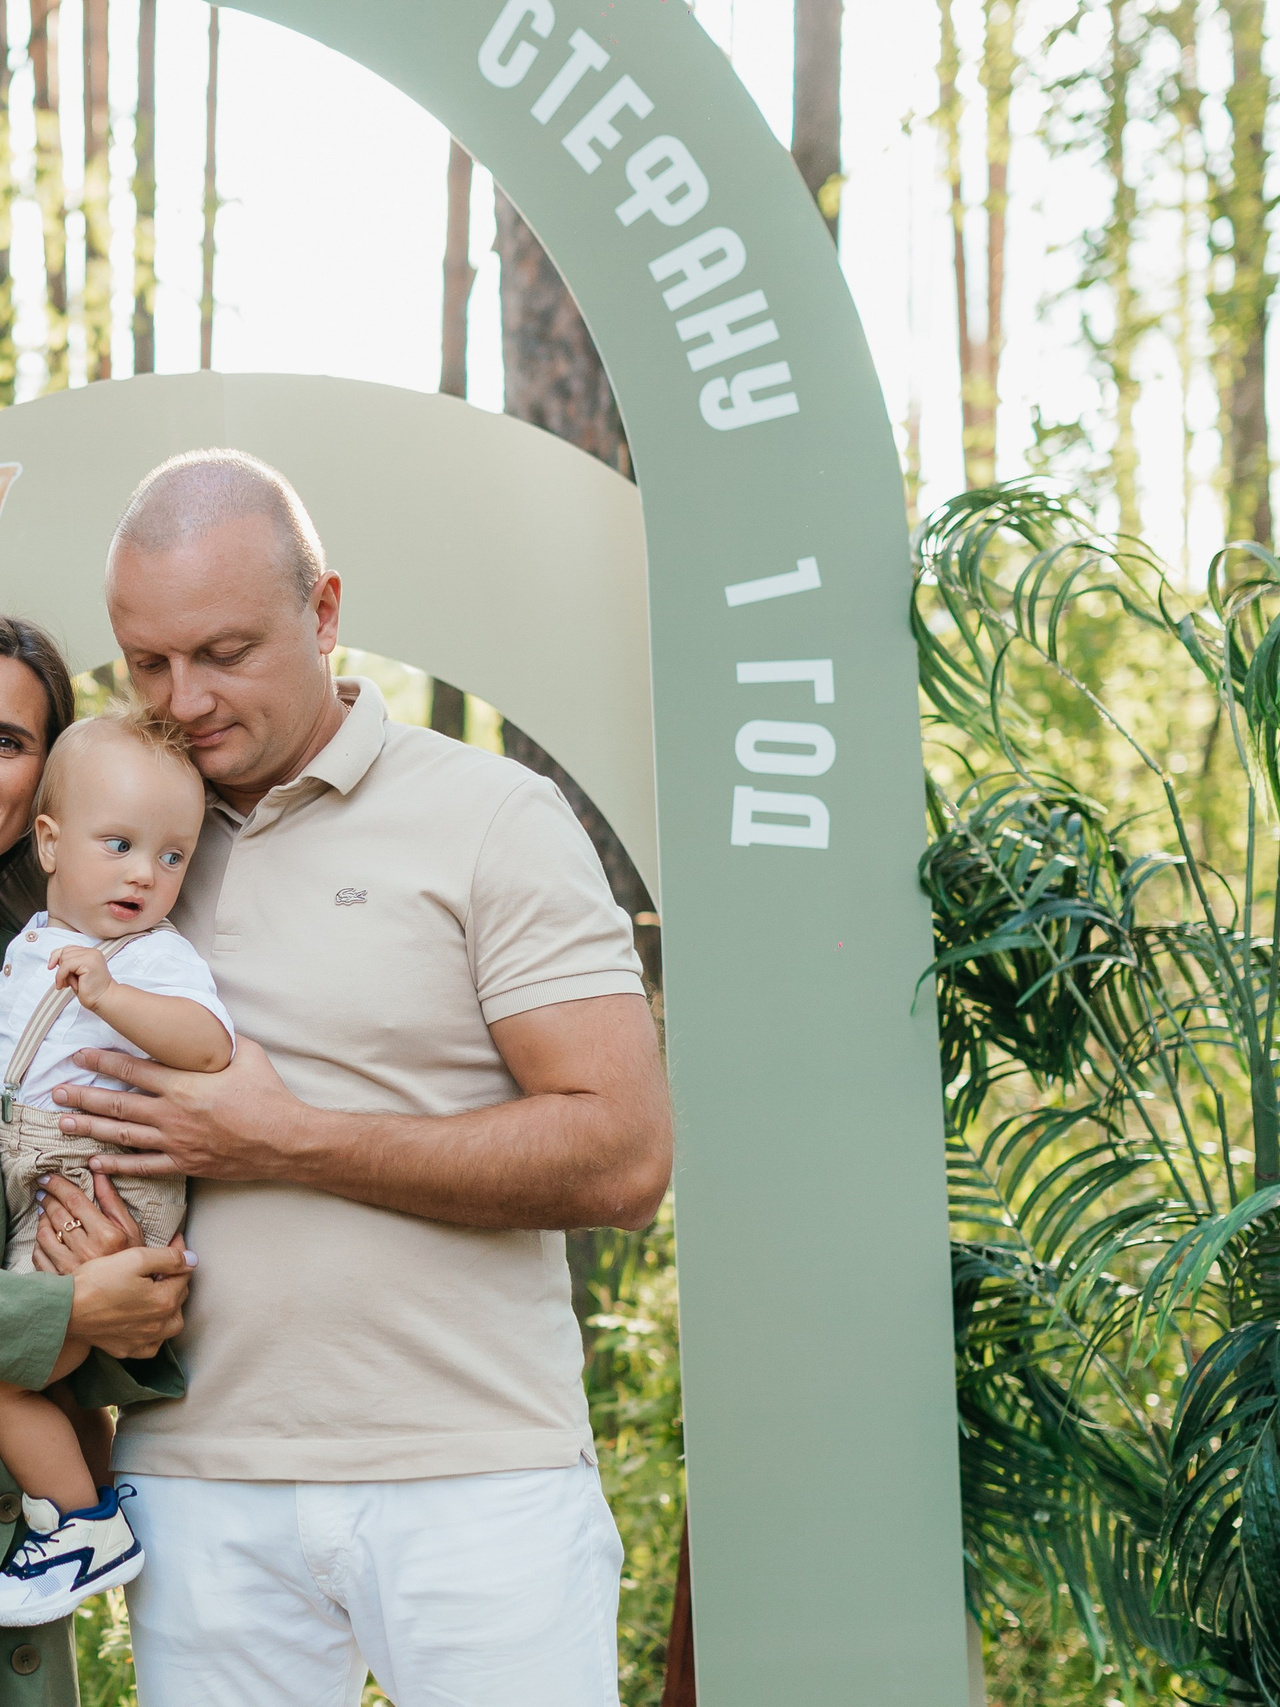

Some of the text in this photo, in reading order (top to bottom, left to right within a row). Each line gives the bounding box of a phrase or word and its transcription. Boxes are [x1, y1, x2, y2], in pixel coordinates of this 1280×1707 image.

[477, 0, 836, 849] СТЕФАНУ 1 ГОД
